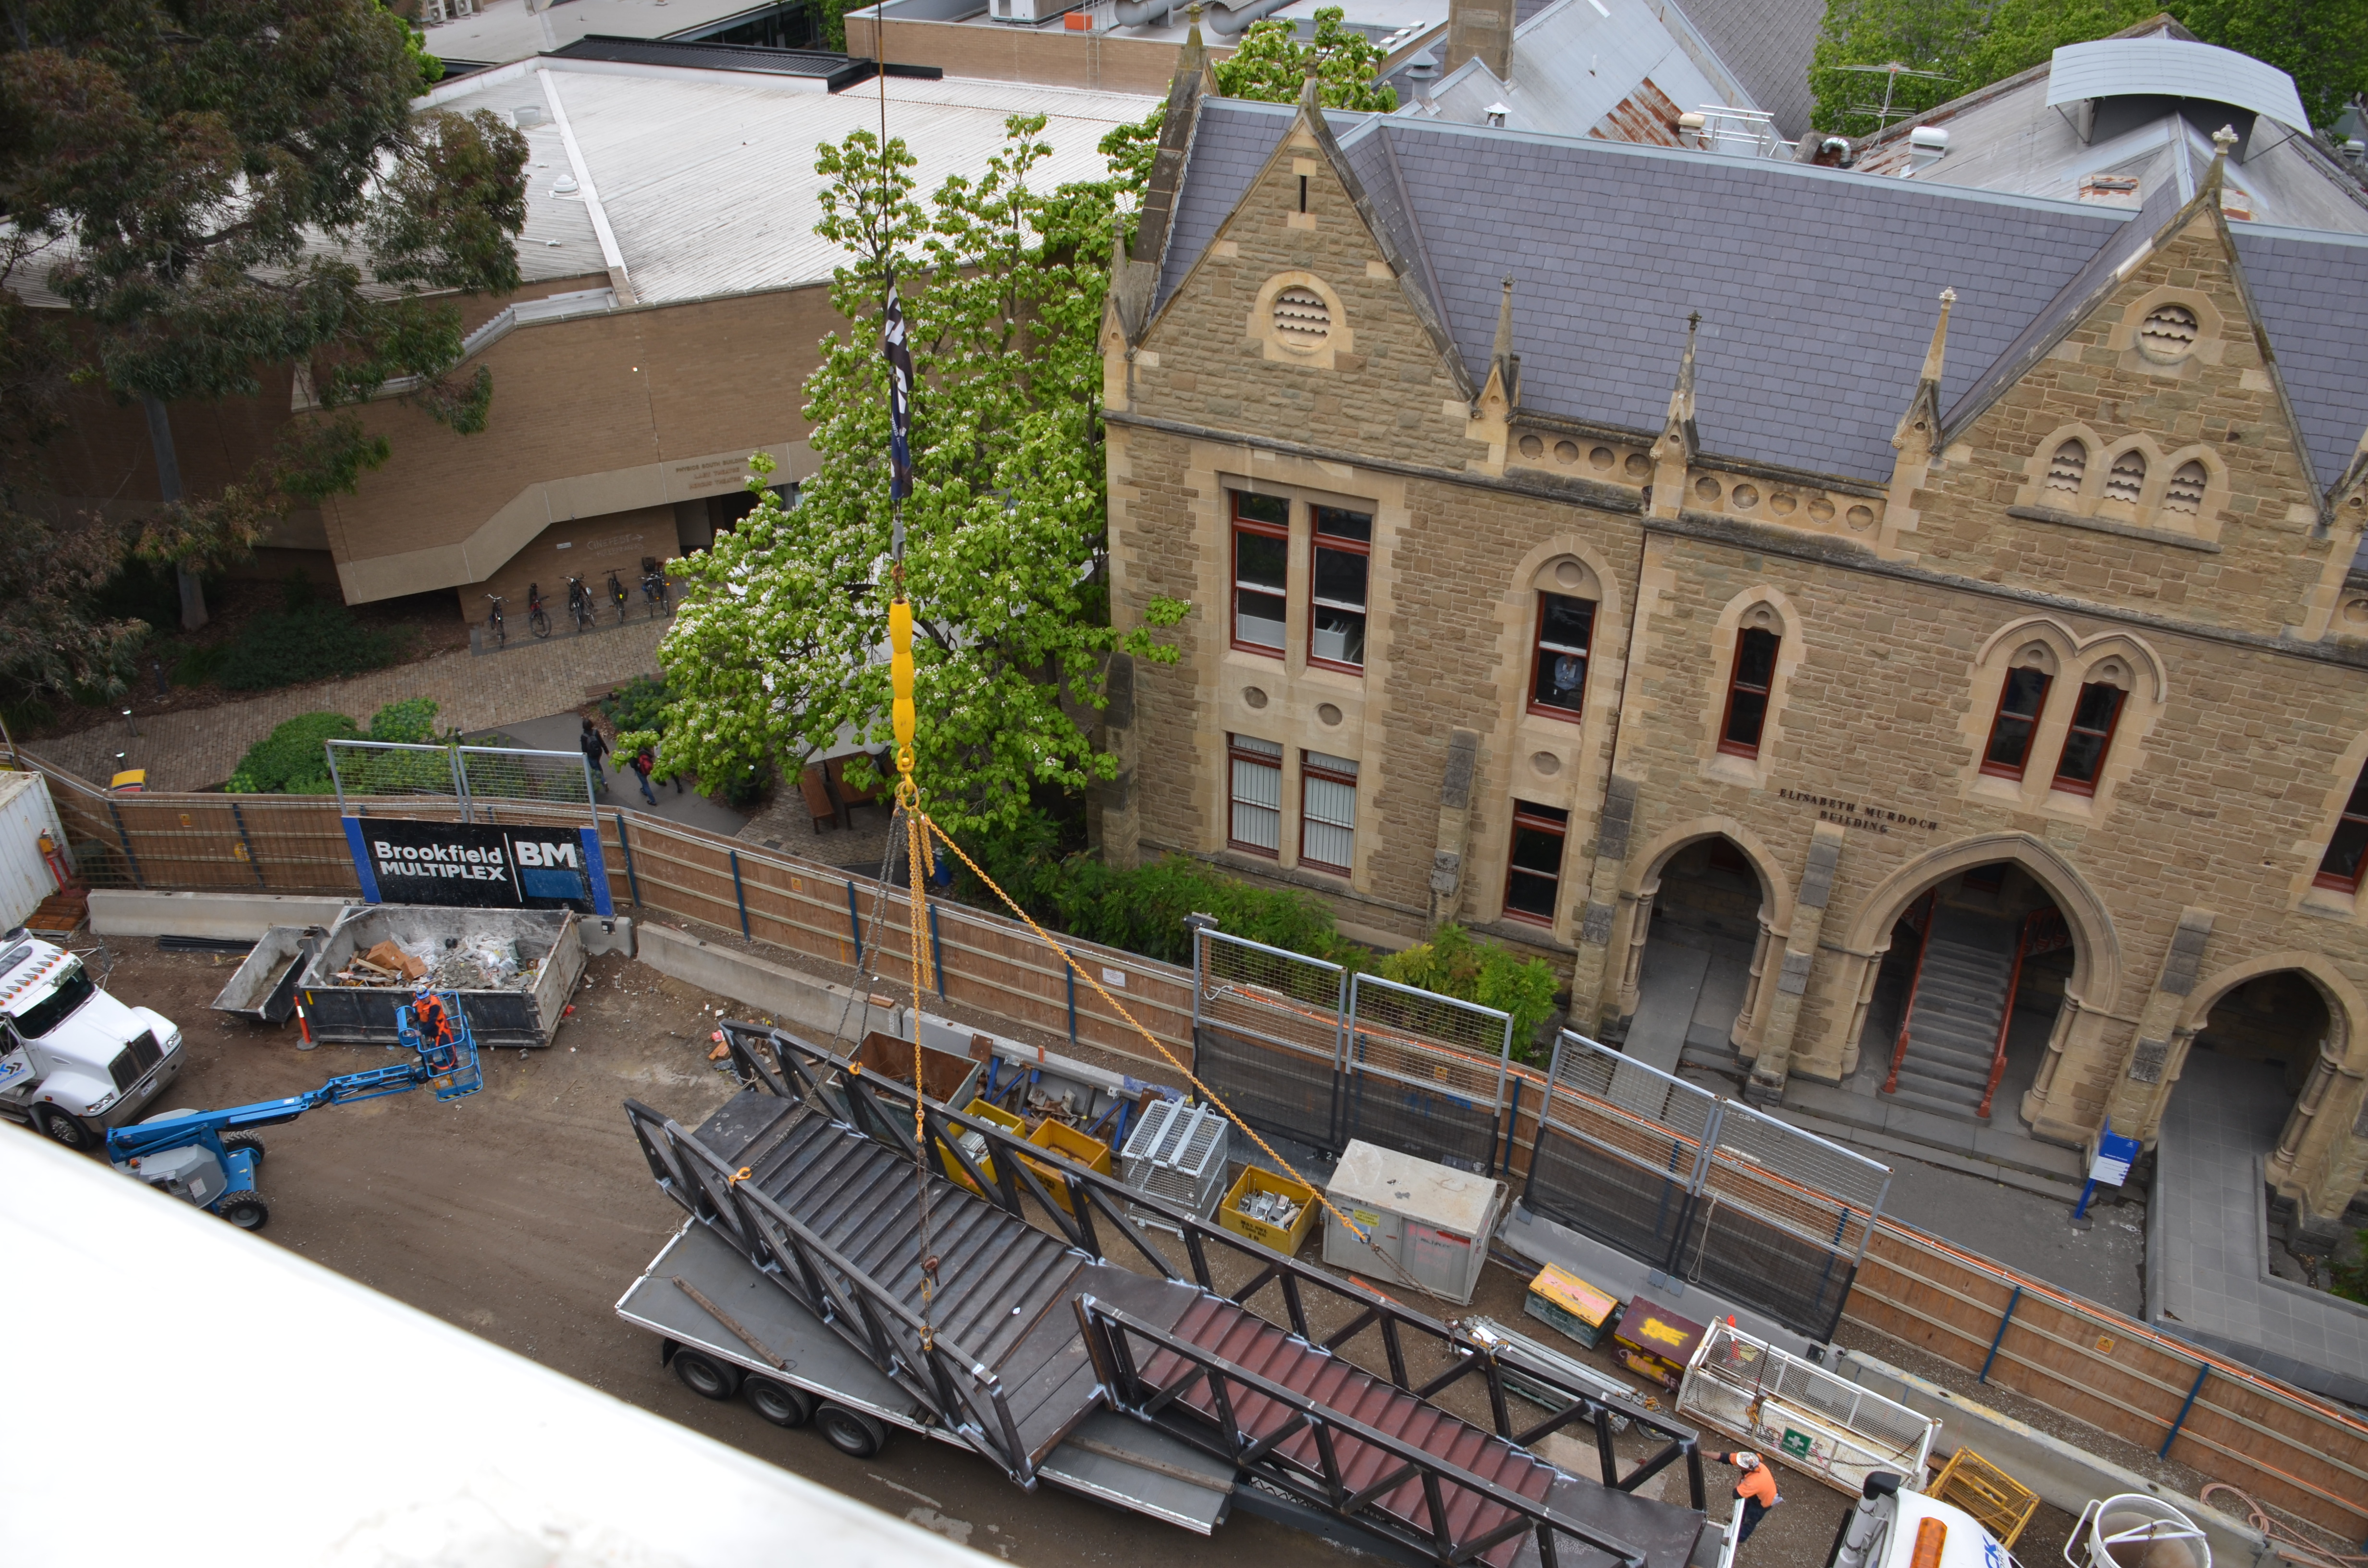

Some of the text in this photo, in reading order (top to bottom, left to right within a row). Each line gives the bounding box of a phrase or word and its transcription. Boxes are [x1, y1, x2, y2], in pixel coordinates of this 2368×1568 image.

[722, 457, 749, 465] BUILDING
[587, 534, 631, 550] CINEFEST
[1779, 788, 1938, 831] ELISABETH MURDOCH
[1820, 810, 1888, 833] BUILDING
[374, 841, 578, 868] Brookfield BM
[380, 861, 507, 882] MULTIPLEX
[1326, 1152, 1332, 1160] 2
[1783, 1441, 1796, 1450] FIRST
